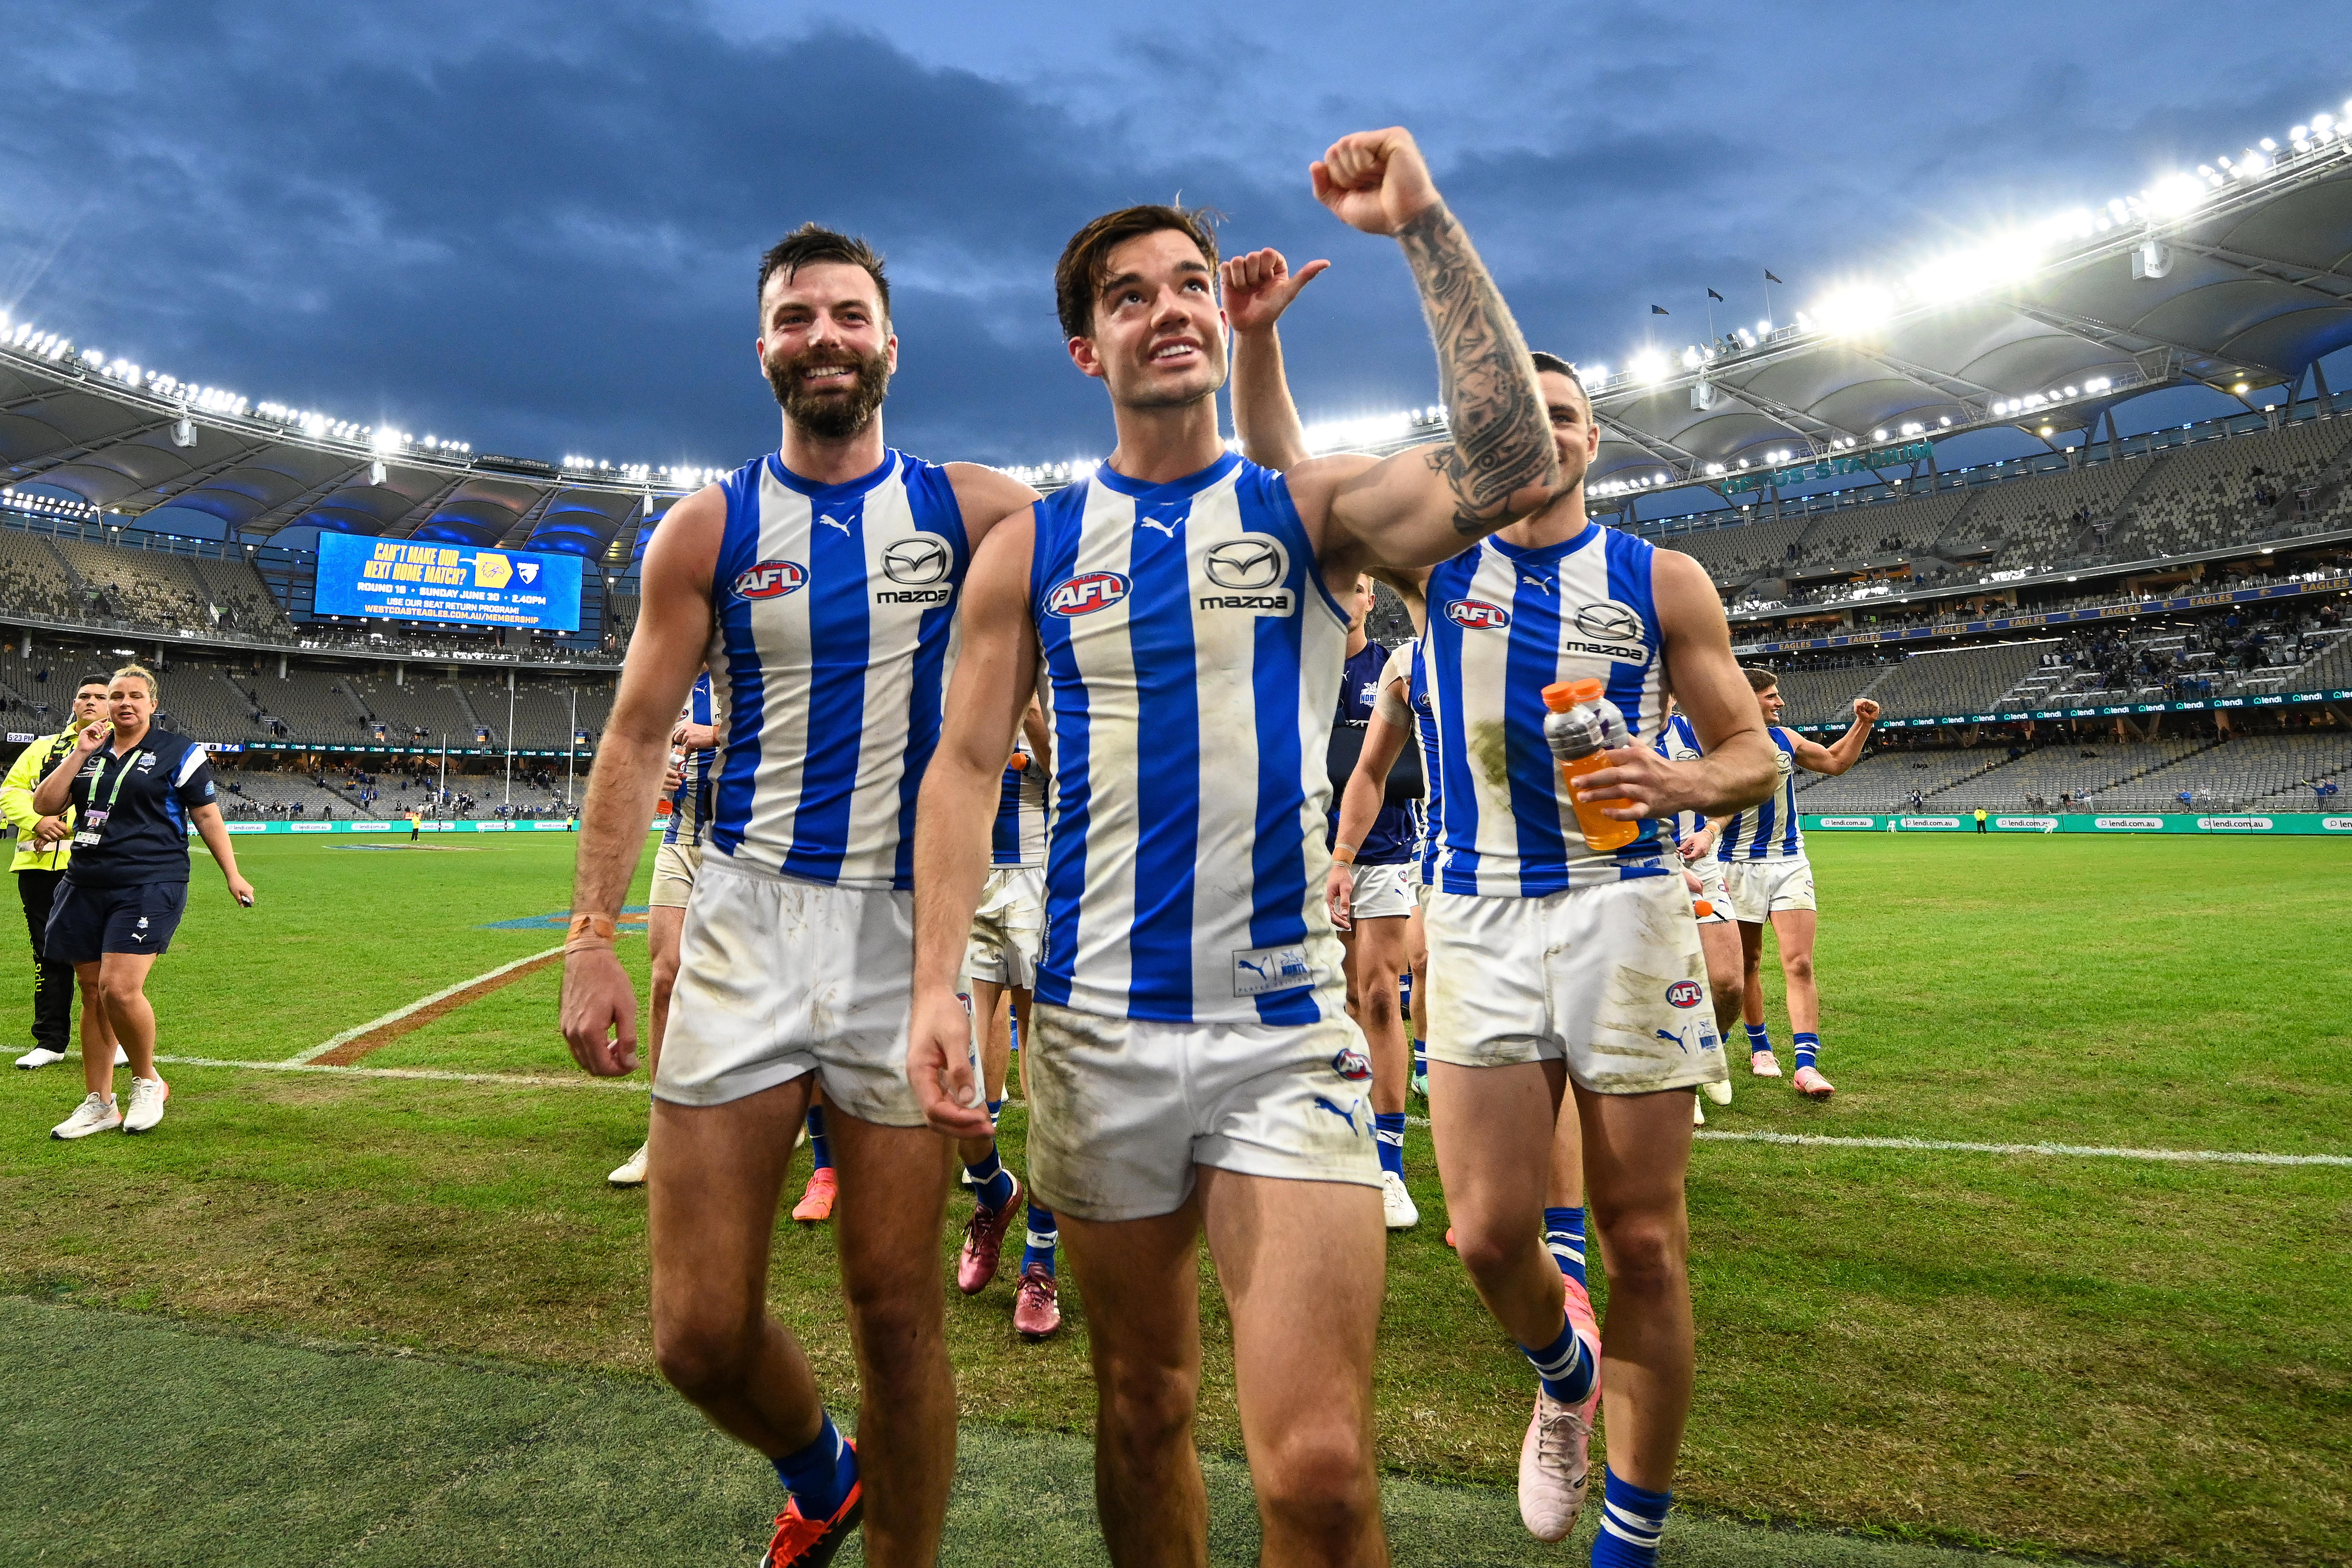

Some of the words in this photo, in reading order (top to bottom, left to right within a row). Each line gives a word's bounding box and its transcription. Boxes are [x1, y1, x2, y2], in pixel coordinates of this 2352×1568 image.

[1721, 469, 1805, 495] OPTUS
[1816, 440, 1933, 480] STADIUM
[374, 542, 407, 562] CAN'T
[407, 546, 437, 565] MAKE
[437, 549, 460, 567] OUR
[363, 560, 392, 579] NEXT
[392, 563, 425, 582] HOME
[424, 565, 467, 585] MATCH?
[737, 569, 802, 592] AFL
[2301, 579, 2349, 592] EAGLES
[358, 582, 393, 593] ROUND
[419, 587, 459, 598] SUNDAY
[459, 590, 485, 600] JUNE
[487, 593, 500, 602] 30
[877, 589, 948, 604] mazda
[1050, 578, 1124, 612] AFL
[2190, 593, 2233, 606] EAGLES
[387, 597, 404, 606] USE
[405, 599, 422, 607] OUR
[423, 600, 444, 609] SEAT
[445, 602, 477, 611] RETURN
[478, 605, 519, 614] PROGRAM!
[1200, 596, 1288, 610] mazda
[1450, 605, 1505, 627] AFL
[2100, 605, 2141, 617] EAGLES
[2009, 616, 2046, 627] EAGLES
[1931, 625, 1968, 635] EAGLES
[1779, 641, 1812, 650] EAGLES
[1848, 634, 1881, 644] EAGLES
[1567, 641, 1644, 661] mazda
[1360, 694, 1376, 703] NORT
[2213, 820, 2264, 828] lendi.com.au
[1670, 986, 1702, 1003] AFL
